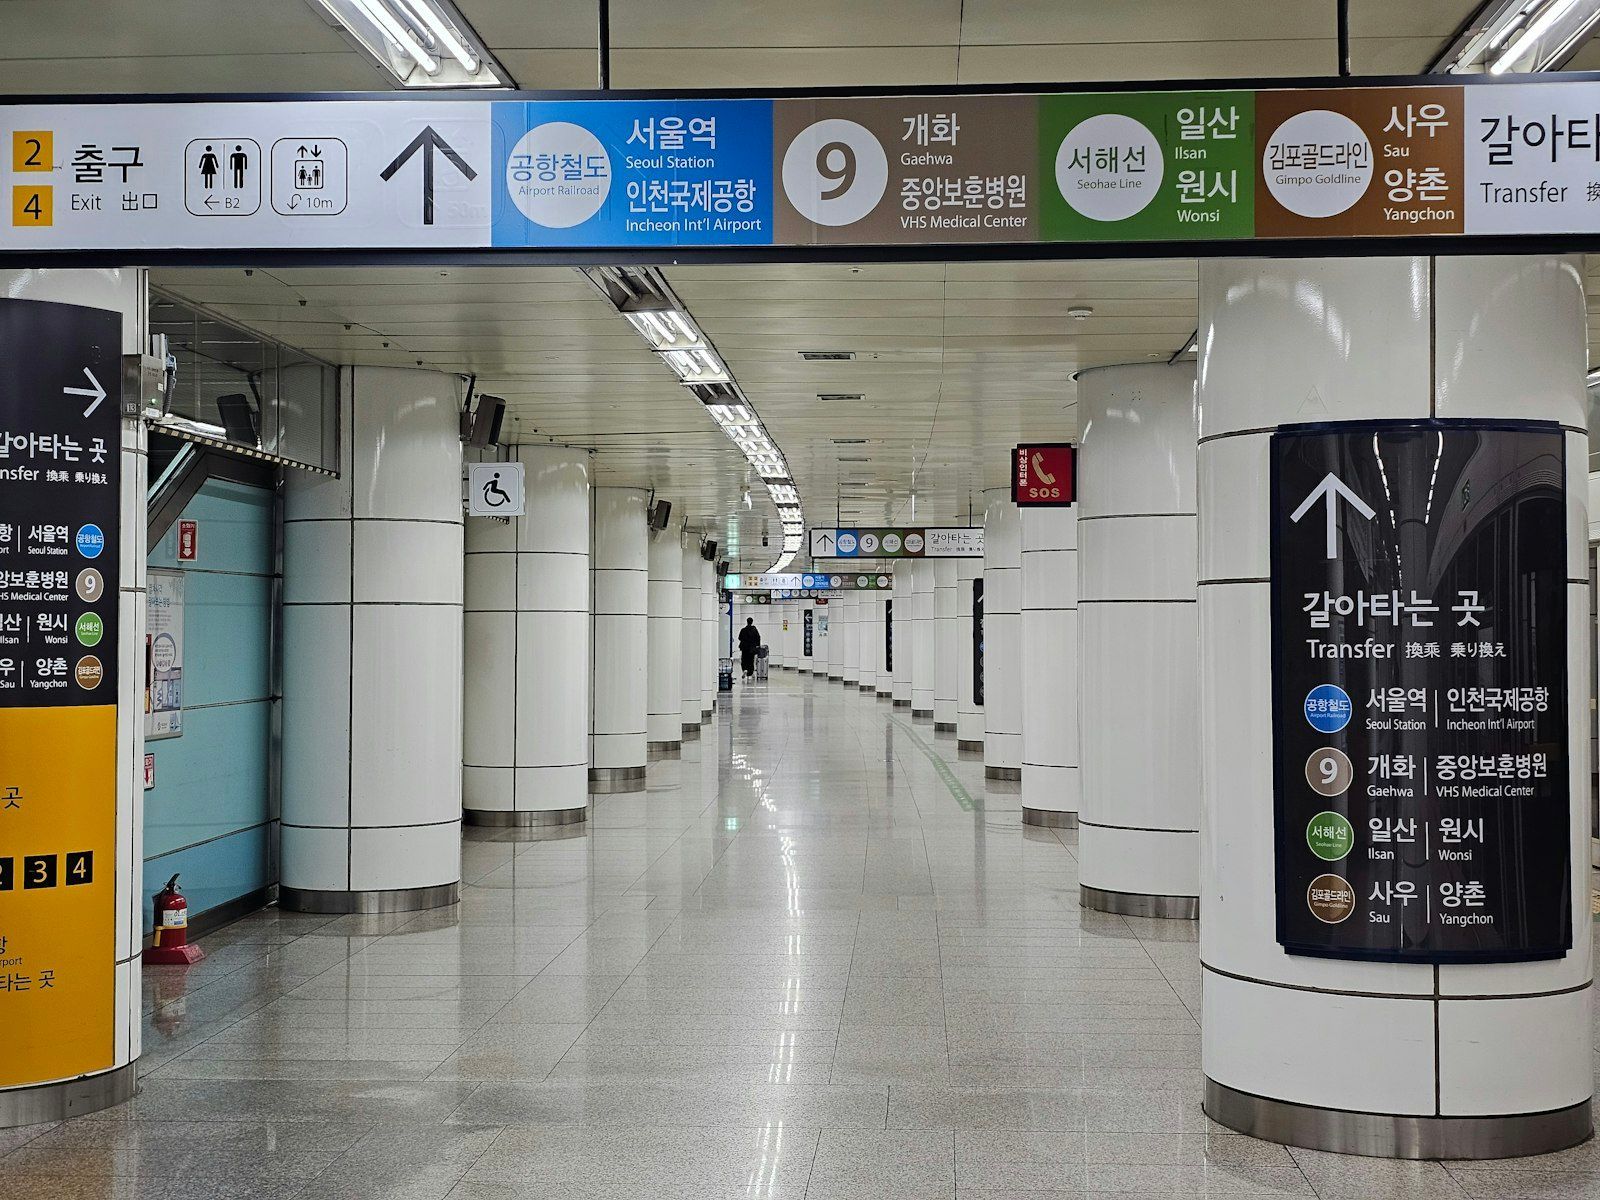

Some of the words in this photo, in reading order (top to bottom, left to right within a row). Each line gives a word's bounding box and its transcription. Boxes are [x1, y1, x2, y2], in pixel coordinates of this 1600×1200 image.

[902, 113, 960, 146] 개화
[1176, 106, 1240, 140] 일산
[1383, 104, 1448, 138] 사우
[626, 116, 716, 150] 서울역
[25, 139, 41, 166] 2
[901, 152, 953, 166] Gaehwa
[1067, 145, 1146, 174] 서해선
[1176, 146, 1207, 160] Ilsan
[1269, 142, 1368, 171] 김포골드라인
[1384, 144, 1410, 158] Sau
[72, 144, 144, 183] 출구
[510, 154, 608, 181] 공항철도
[626, 156, 663, 168] Seoul
[667, 156, 714, 168] Station
[816, 141, 856, 200] 9
[1077, 178, 1117, 190] Seohae
[1120, 178, 1142, 188] Line
[1176, 170, 1237, 204] 원시
[1276, 174, 1312, 186] Gimpo
[1315, 173, 1361, 184] Goldline
[1384, 167, 1449, 202] 양촌
[518, 186, 554, 198] Airport
[558, 185, 600, 196] Railroad
[626, 178, 756, 213] 인천국제공항
[900, 174, 1026, 210] 중앙보훈병원
[1480, 180, 1568, 204] Transfer
[23, 193, 42, 220] 4
[71, 193, 102, 211] Exit
[122, 192, 158, 210] 出口
[225, 196, 240, 210] B2
[306, 196, 333, 210] 10m
[900, 216, 927, 229] VHS
[930, 215, 980, 228] Medical
[984, 214, 1028, 228] Center
[1176, 209, 1220, 222] Wonsi
[1384, 206, 1455, 224] Yangchon
[626, 218, 680, 232] Incheon
[684, 218, 710, 231] Int'l
[713, 219, 762, 234] Airport
[88, 438, 108, 464] 곳
[1029, 488, 1060, 498] SOS
[28, 524, 68, 543] 서울역
[930, 533, 972, 544] 갈아타는
[28, 546, 46, 554] Seoul
[46, 546, 68, 555] Station
[866, 538, 874, 548] 9
[84, 575, 96, 594] 9
[11, 592, 42, 600] Medical
[44, 592, 69, 601] Center
[1302, 590, 1440, 628] 갈아타는
[1452, 590, 1486, 627] 곳
[36, 613, 68, 632] 원시
[45, 636, 68, 644] Wonsi
[1306, 638, 1395, 659] Transfer
[1406, 642, 1440, 658] 換乘
[1450, 642, 1507, 658] 乗り換え
[36, 658, 68, 676] 양촌
[0, 680, 16, 688] Sau
[30, 679, 68, 690] Yangchon
[1306, 698, 1350, 712] 공항철도
[1366, 687, 1426, 712] 서울역
[1447, 686, 1550, 712] 인천국제공항
[1366, 718, 1392, 730] Seoul
[1394, 718, 1426, 730] Station
[1447, 718, 1486, 730] Incheon
[1506, 718, 1535, 732] Airport
[1319, 758, 1338, 784] 9
[1367, 754, 1416, 780] 개화
[1436, 753, 1547, 780] 중앙보훈병원
[2, 787, 23, 808] 곳
[1366, 786, 1414, 798] Gaehwa
[1436, 786, 1460, 798] VHS
[1462, 786, 1502, 798] Medical
[1504, 786, 1534, 796] Center
[1312, 826, 1347, 840] 서해선
[1368, 818, 1418, 844] 일산
[1438, 818, 1484, 844] 원시
[1368, 848, 1394, 860] Ilsan
[1438, 850, 1472, 861] Wonsi
[34, 860, 48, 883] 3
[72, 856, 86, 878] 4
[1311, 888, 1351, 903] 김포골드라인
[1368, 880, 1418, 906] 사우
[1440, 880, 1486, 907] 양촌
[1369, 911, 1390, 924] Sau
[1440, 912, 1494, 928] Yangchon
[38, 970, 55, 988] 곳
